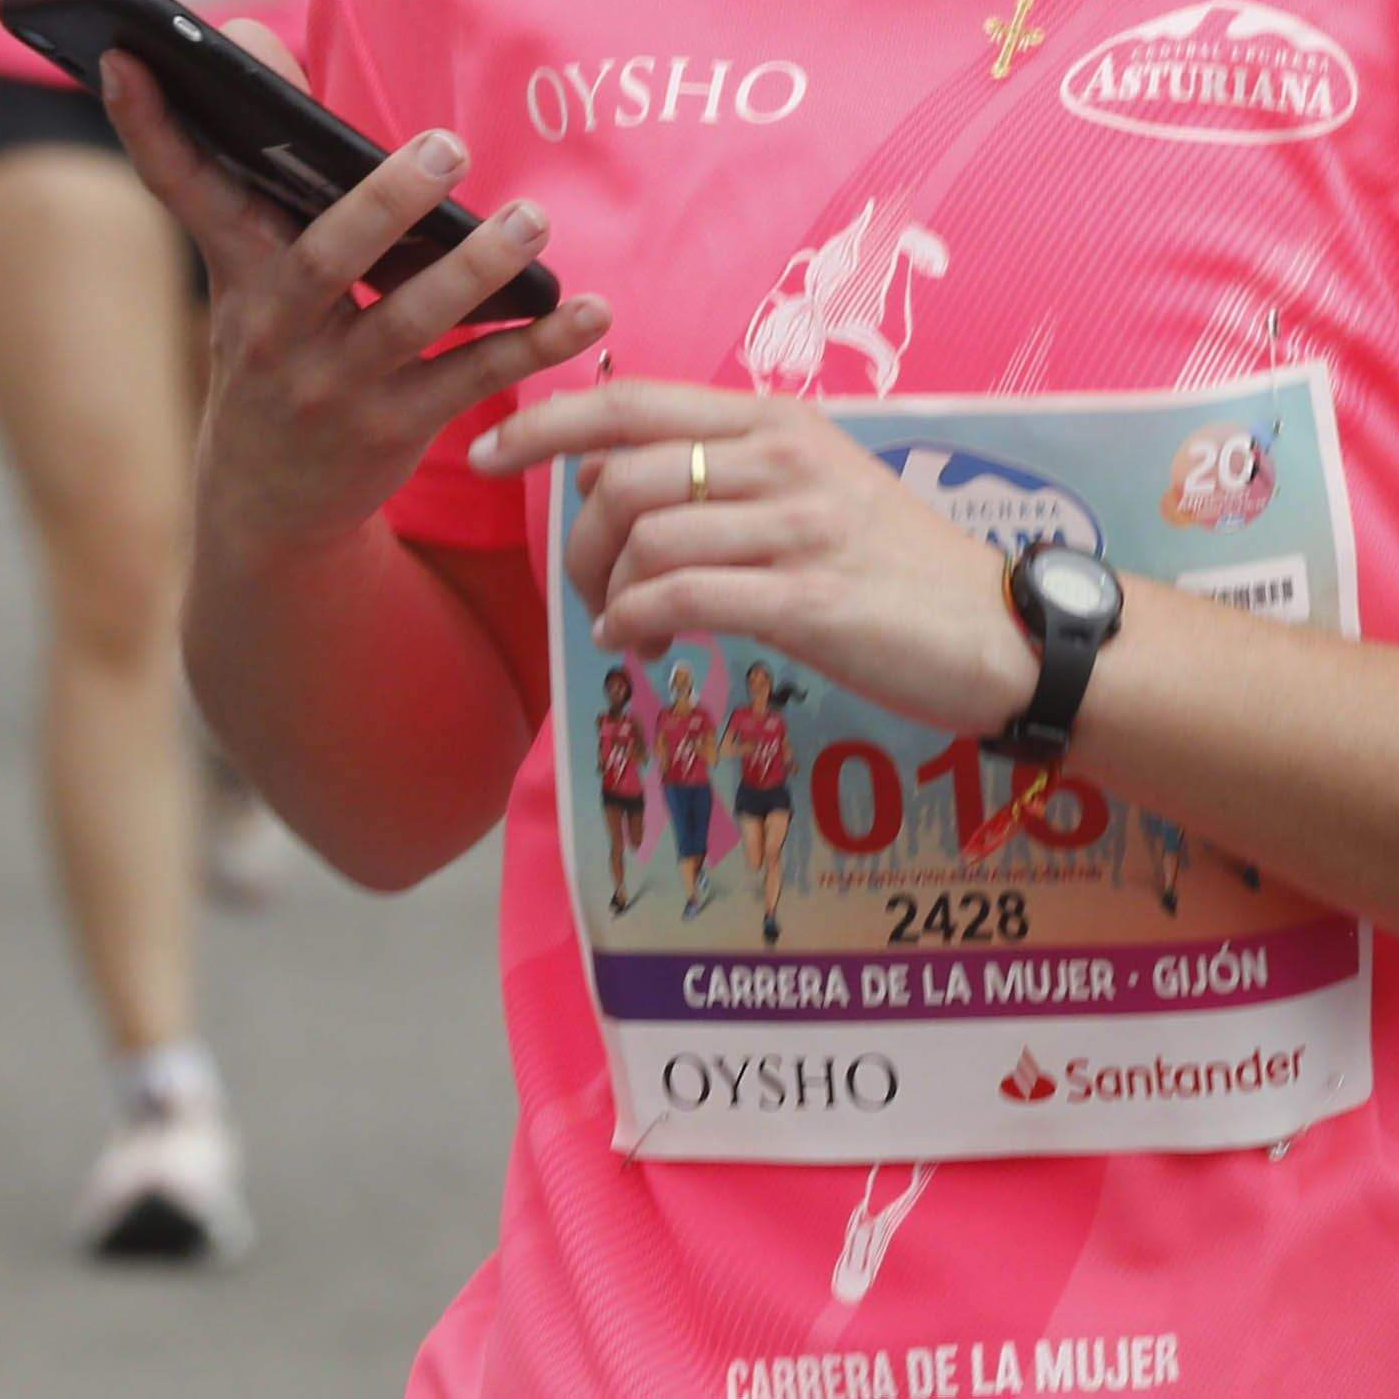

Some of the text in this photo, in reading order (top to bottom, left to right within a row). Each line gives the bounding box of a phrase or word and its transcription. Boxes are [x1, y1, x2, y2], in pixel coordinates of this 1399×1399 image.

[525, 55, 806, 141] OYSHO
[1080, 50, 1335, 121] ASTURIANA
[885, 890, 1031, 945] 2428
[683, 964, 850, 1010] CARRERA
[861, 961, 910, 1008] DE
[921, 958, 972, 1005] LA
[983, 956, 1115, 1003] MUJER
[1152, 940, 1268, 998] GIJÓN
[662, 1051, 898, 1111] OYSHO
[1065, 1045, 1306, 1102] Santander
[727, 1332, 1179, 1399] CARRERA DE LA MUJER
